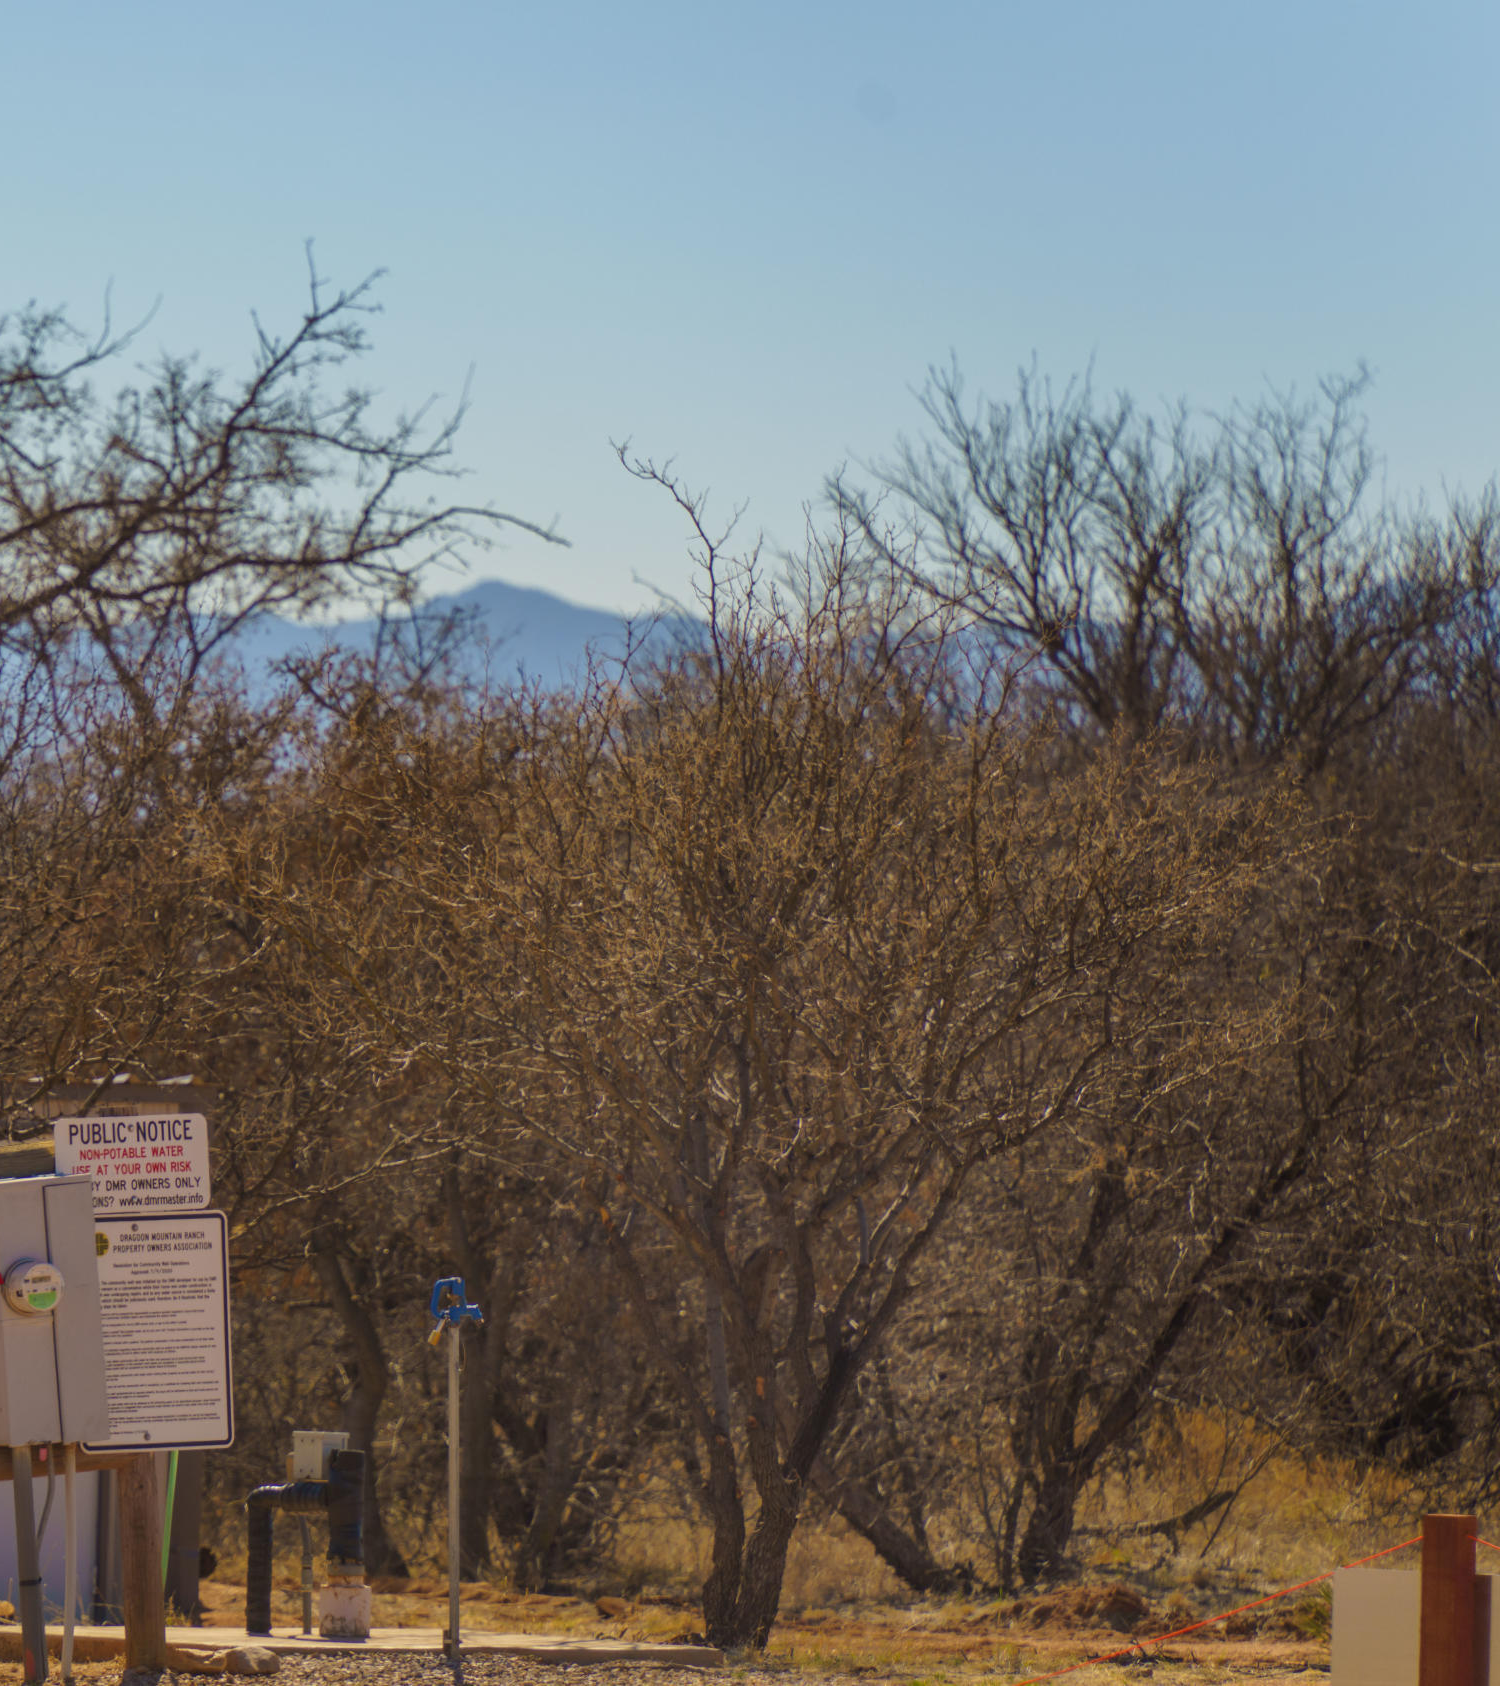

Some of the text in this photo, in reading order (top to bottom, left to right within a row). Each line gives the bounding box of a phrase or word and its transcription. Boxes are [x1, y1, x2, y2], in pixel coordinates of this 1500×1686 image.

[69, 1120, 193, 1146] PUBLIC NOTICE
[79, 1145, 184, 1161] NON-POTABLE WATER
[71, 1160, 192, 1176] USE AT YOUR OWN RISK
[105, 1179, 127, 1192] DMR
[131, 1177, 171, 1191] OWNERS
[175, 1176, 201, 1189] ONLY
[119, 1192, 204, 1207] www.dmrmaster.info
[151, 1231, 183, 1241] MOUNTAIN
[184, 1231, 205, 1240] RANCH
[113, 1241, 213, 1254] PROPERTY OWNERS ASSOCIATION
